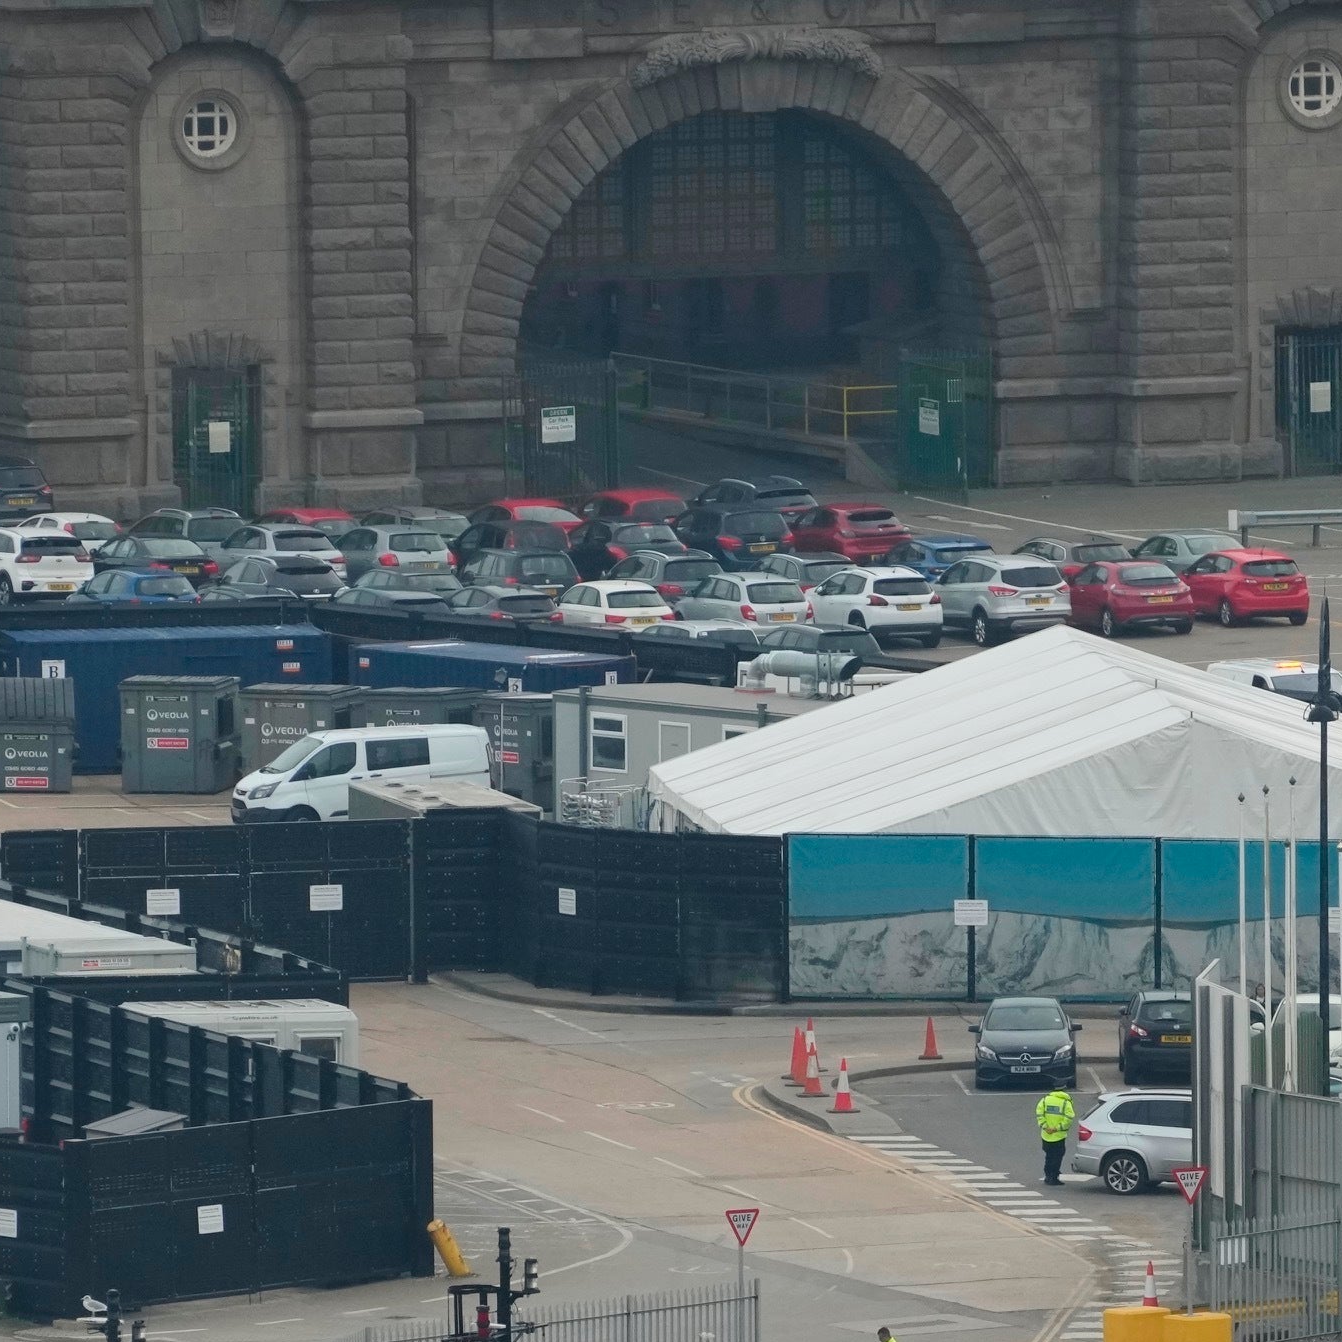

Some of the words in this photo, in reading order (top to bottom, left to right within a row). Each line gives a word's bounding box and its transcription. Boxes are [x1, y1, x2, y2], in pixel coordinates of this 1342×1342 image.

[49, 666, 59, 678] B
[158, 711, 189, 719] VEOLIA
[274, 726, 309, 736] VEOLIA
[17, 750, 48, 758] VEOLIA
[1179, 1173, 1200, 1181] GIVE
[732, 1214, 752, 1222] GIVE
